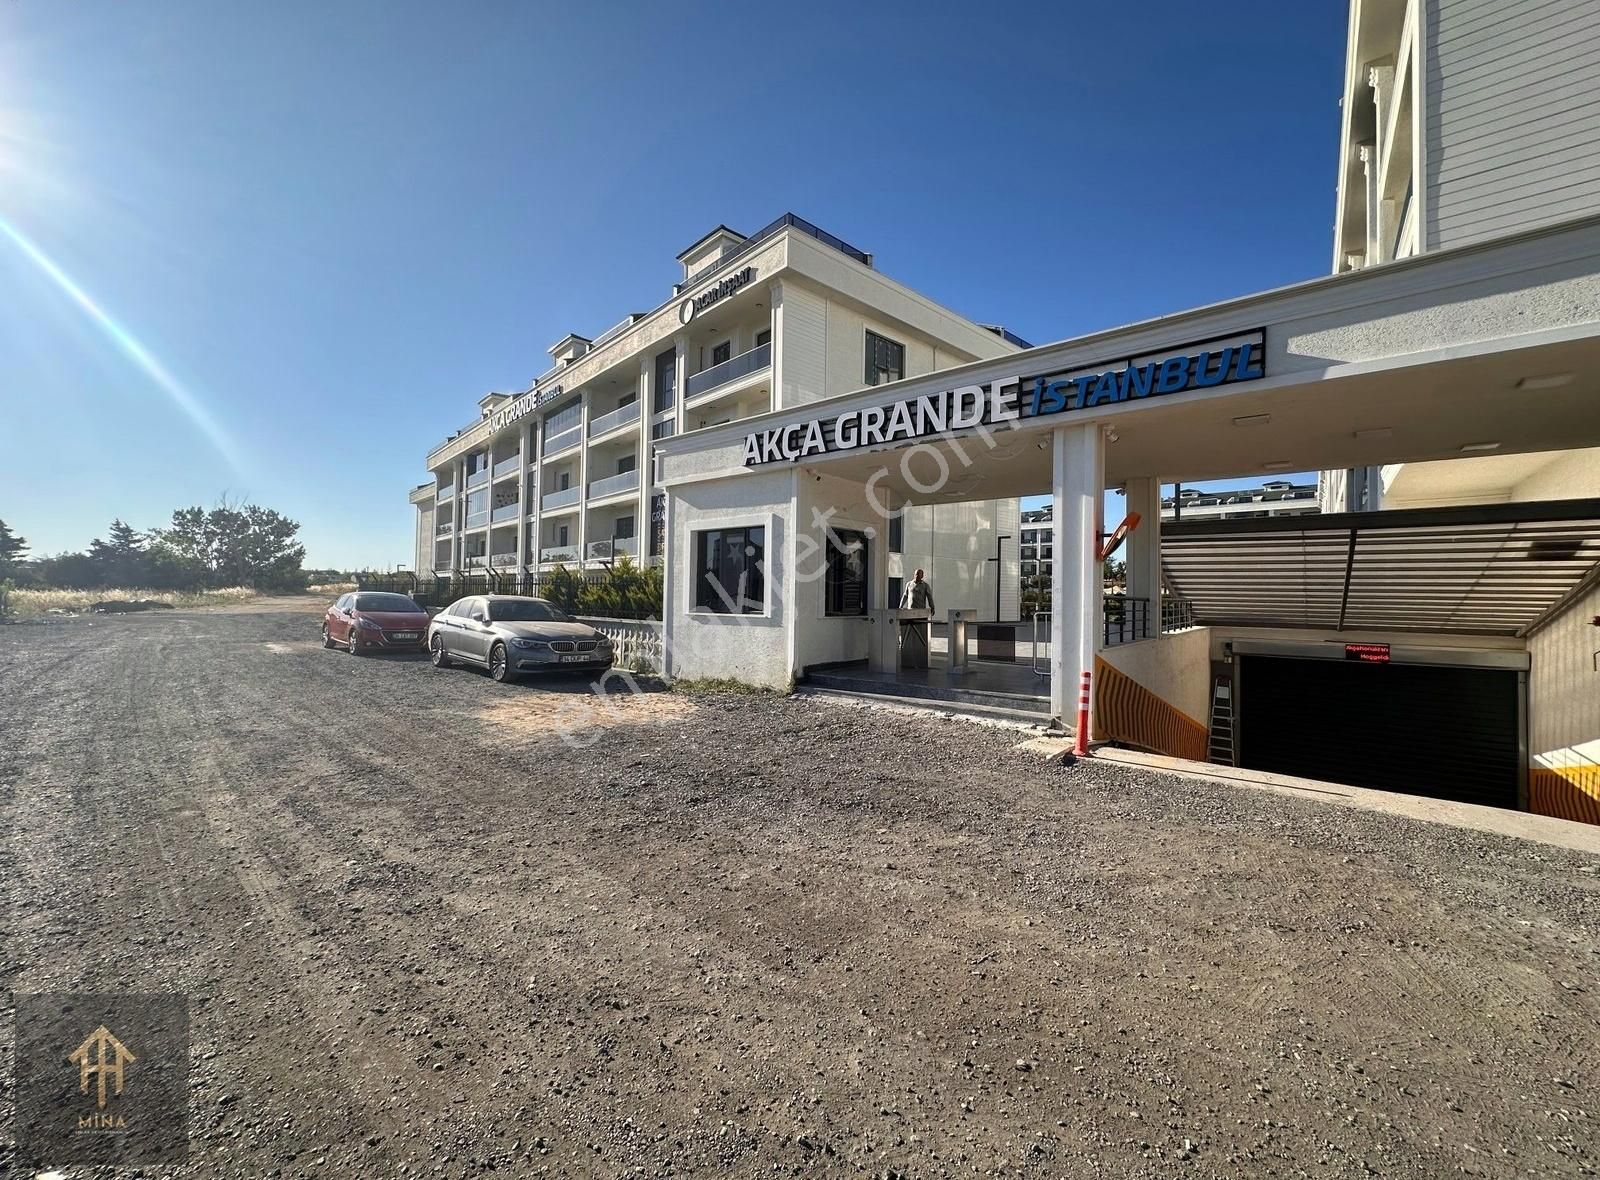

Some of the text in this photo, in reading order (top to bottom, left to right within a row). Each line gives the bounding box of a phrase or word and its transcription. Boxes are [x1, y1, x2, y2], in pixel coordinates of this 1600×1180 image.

[505, 389, 538, 426] GRANDE
[742, 422, 826, 466] AKÇA
[834, 376, 1020, 451] GRANDE
